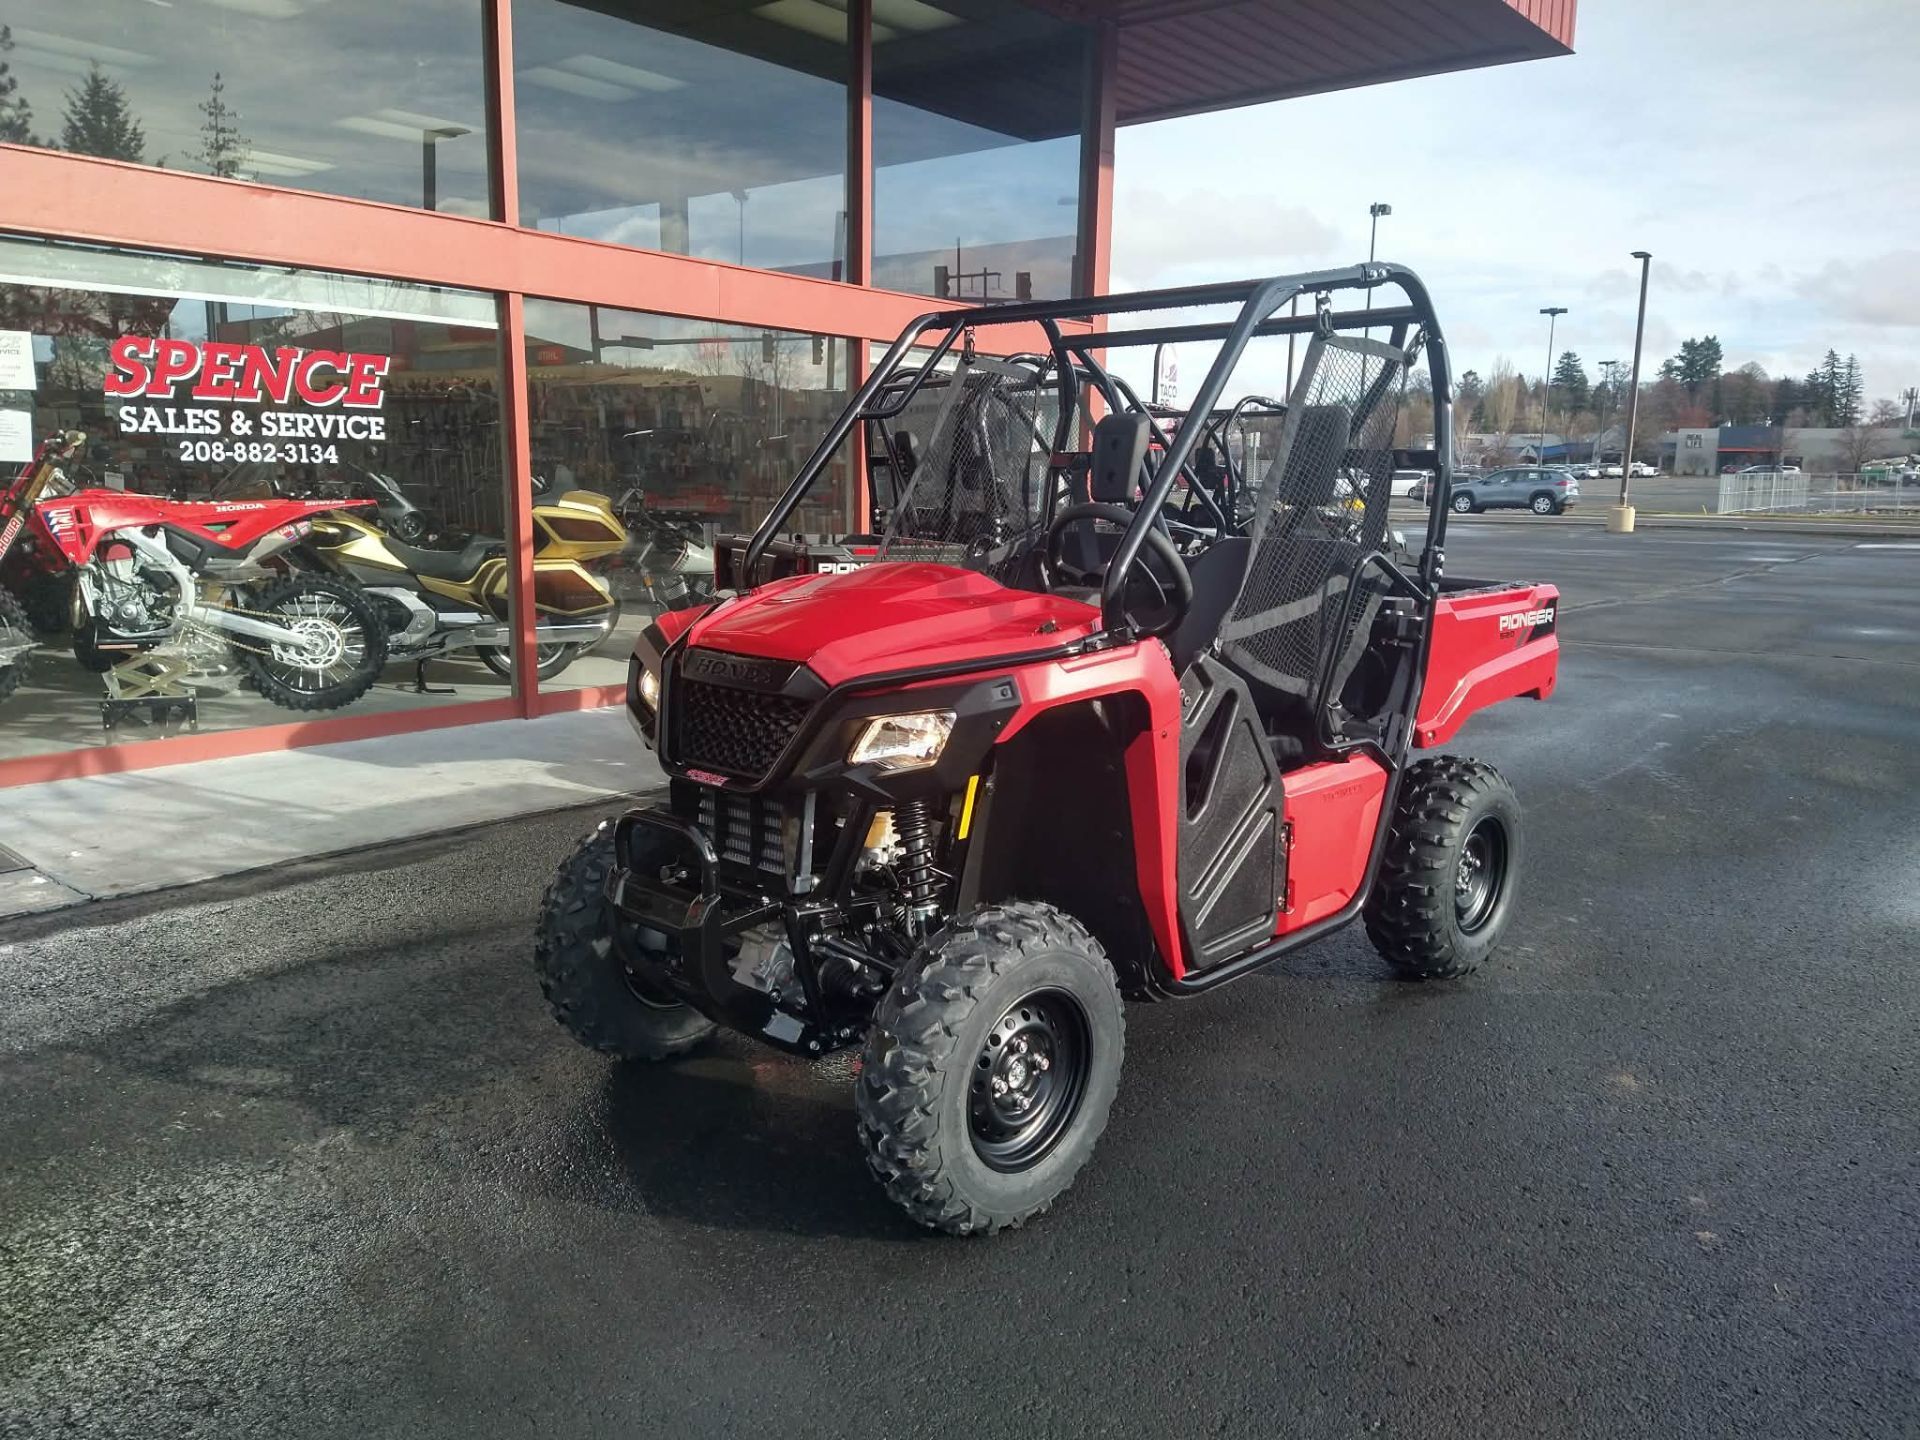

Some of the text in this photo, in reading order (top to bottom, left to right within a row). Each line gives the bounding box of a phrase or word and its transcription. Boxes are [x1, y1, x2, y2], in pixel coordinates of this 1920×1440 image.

[103, 334, 390, 409] SPENCE
[1160, 384, 1177, 398] TACO
[120, 406, 386, 441] SALES & SERVICE
[179, 441, 338, 464] 208-882-3134
[216, 503, 266, 512] HONDA
[0, 518, 20, 556] HOWA
[818, 562, 871, 574] PION
[1499, 608, 1555, 631] PIONEER
